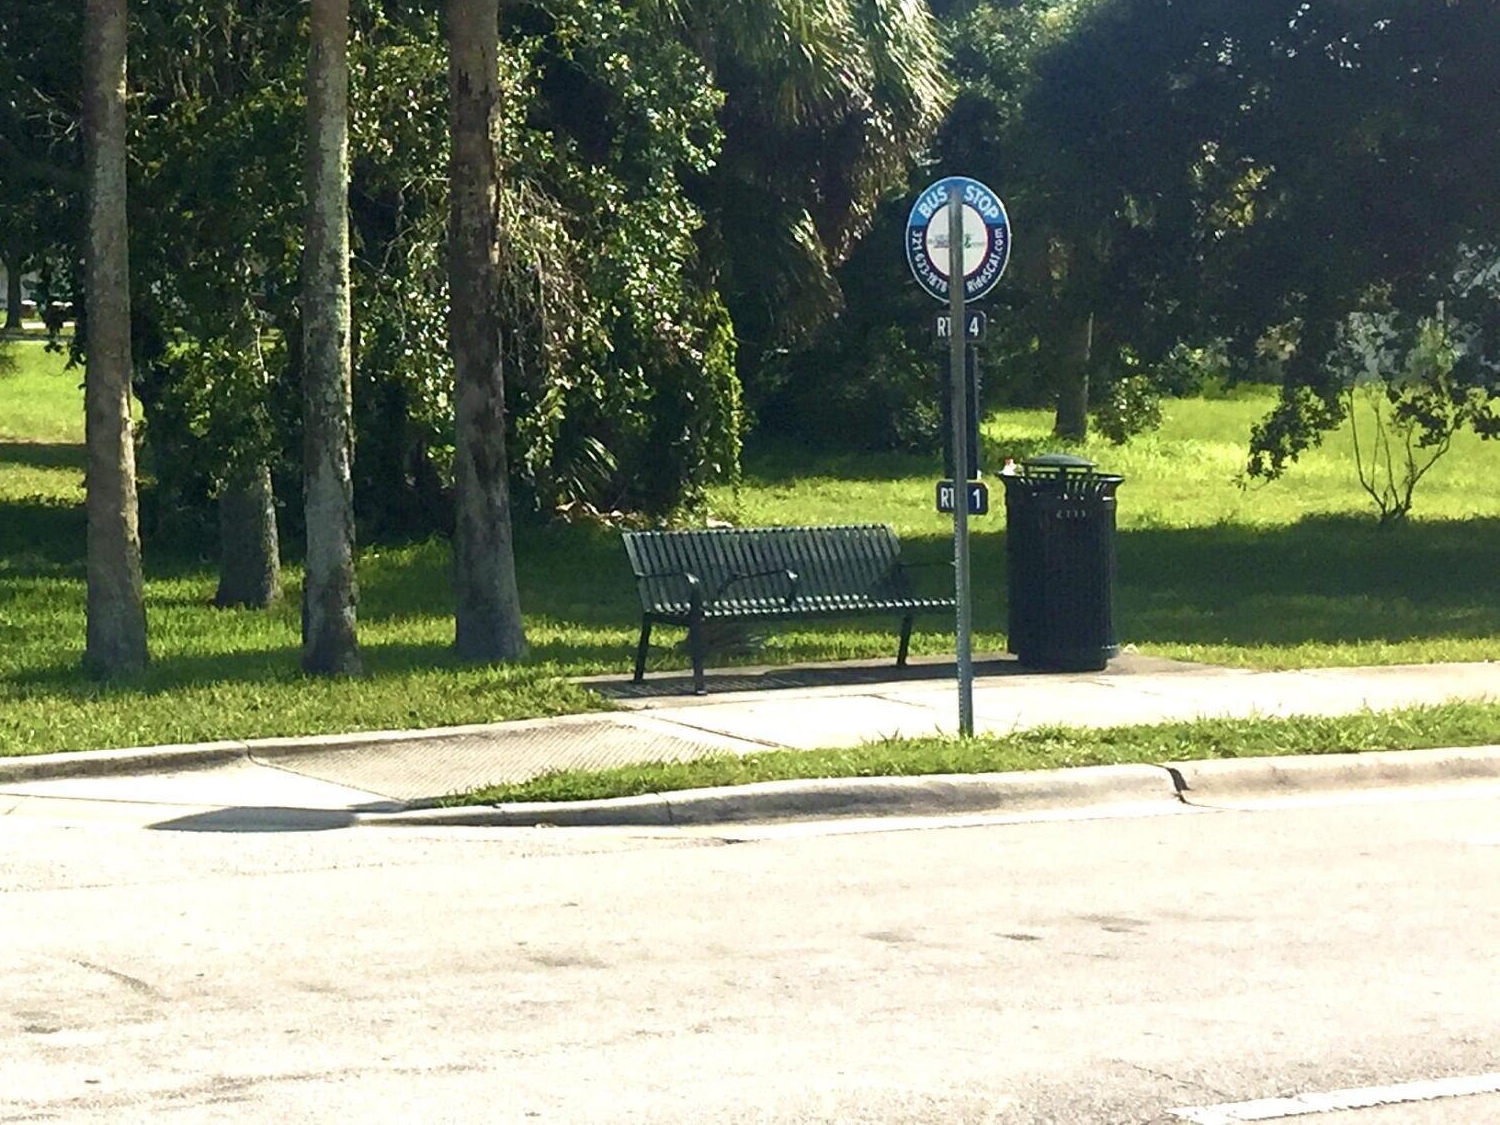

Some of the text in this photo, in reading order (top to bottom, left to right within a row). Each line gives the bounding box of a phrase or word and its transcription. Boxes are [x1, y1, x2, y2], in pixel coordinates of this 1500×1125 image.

[918, 185, 999, 219] BUS STOP
[966, 228, 1004, 293] RideSCAT.com
[968, 316, 979, 337] 4
[972, 488, 981, 510] 1
